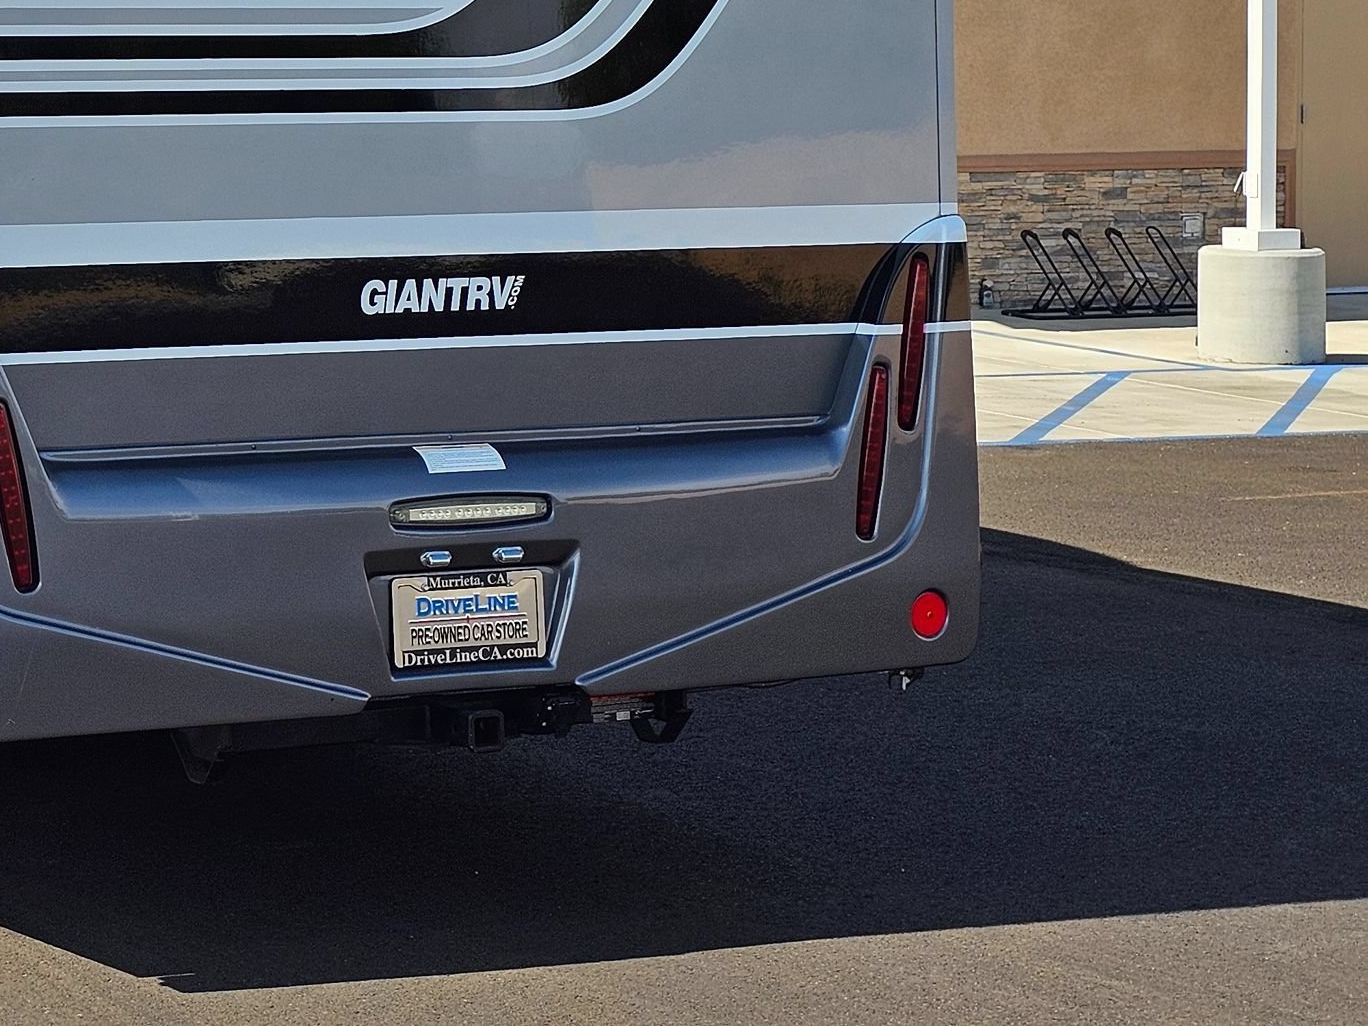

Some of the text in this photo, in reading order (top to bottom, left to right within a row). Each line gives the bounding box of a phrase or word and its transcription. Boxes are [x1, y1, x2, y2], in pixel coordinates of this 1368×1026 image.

[360, 276, 515, 315] GIANTRV
[429, 573, 506, 589] Murrieta, CA
[410, 620, 529, 646] PRE-OWNED CAR STORE
[404, 645, 537, 667] DriveLineCA.com
